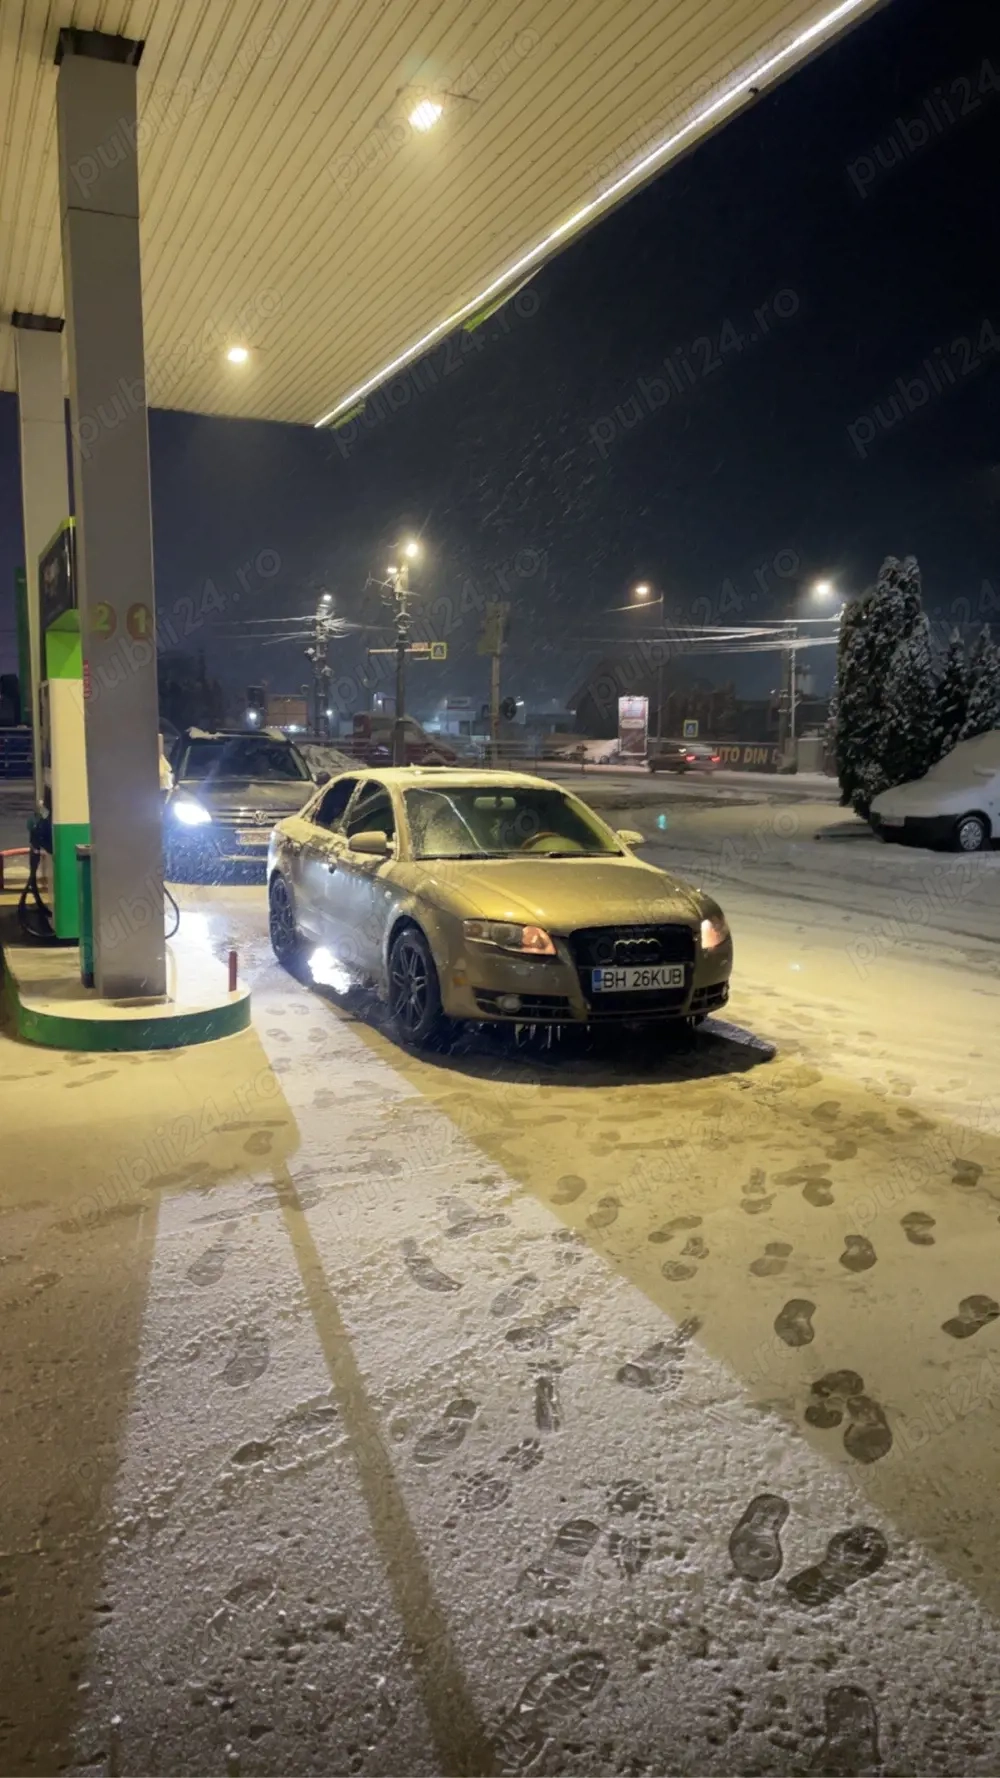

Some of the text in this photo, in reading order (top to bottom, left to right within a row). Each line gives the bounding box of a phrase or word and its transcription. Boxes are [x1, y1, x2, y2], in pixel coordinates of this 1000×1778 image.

[94, 604, 110, 632] 2
[133, 607, 146, 633] 1
[743, 747, 769, 764] DIN
[603, 968, 682, 988] BH 26KUB
